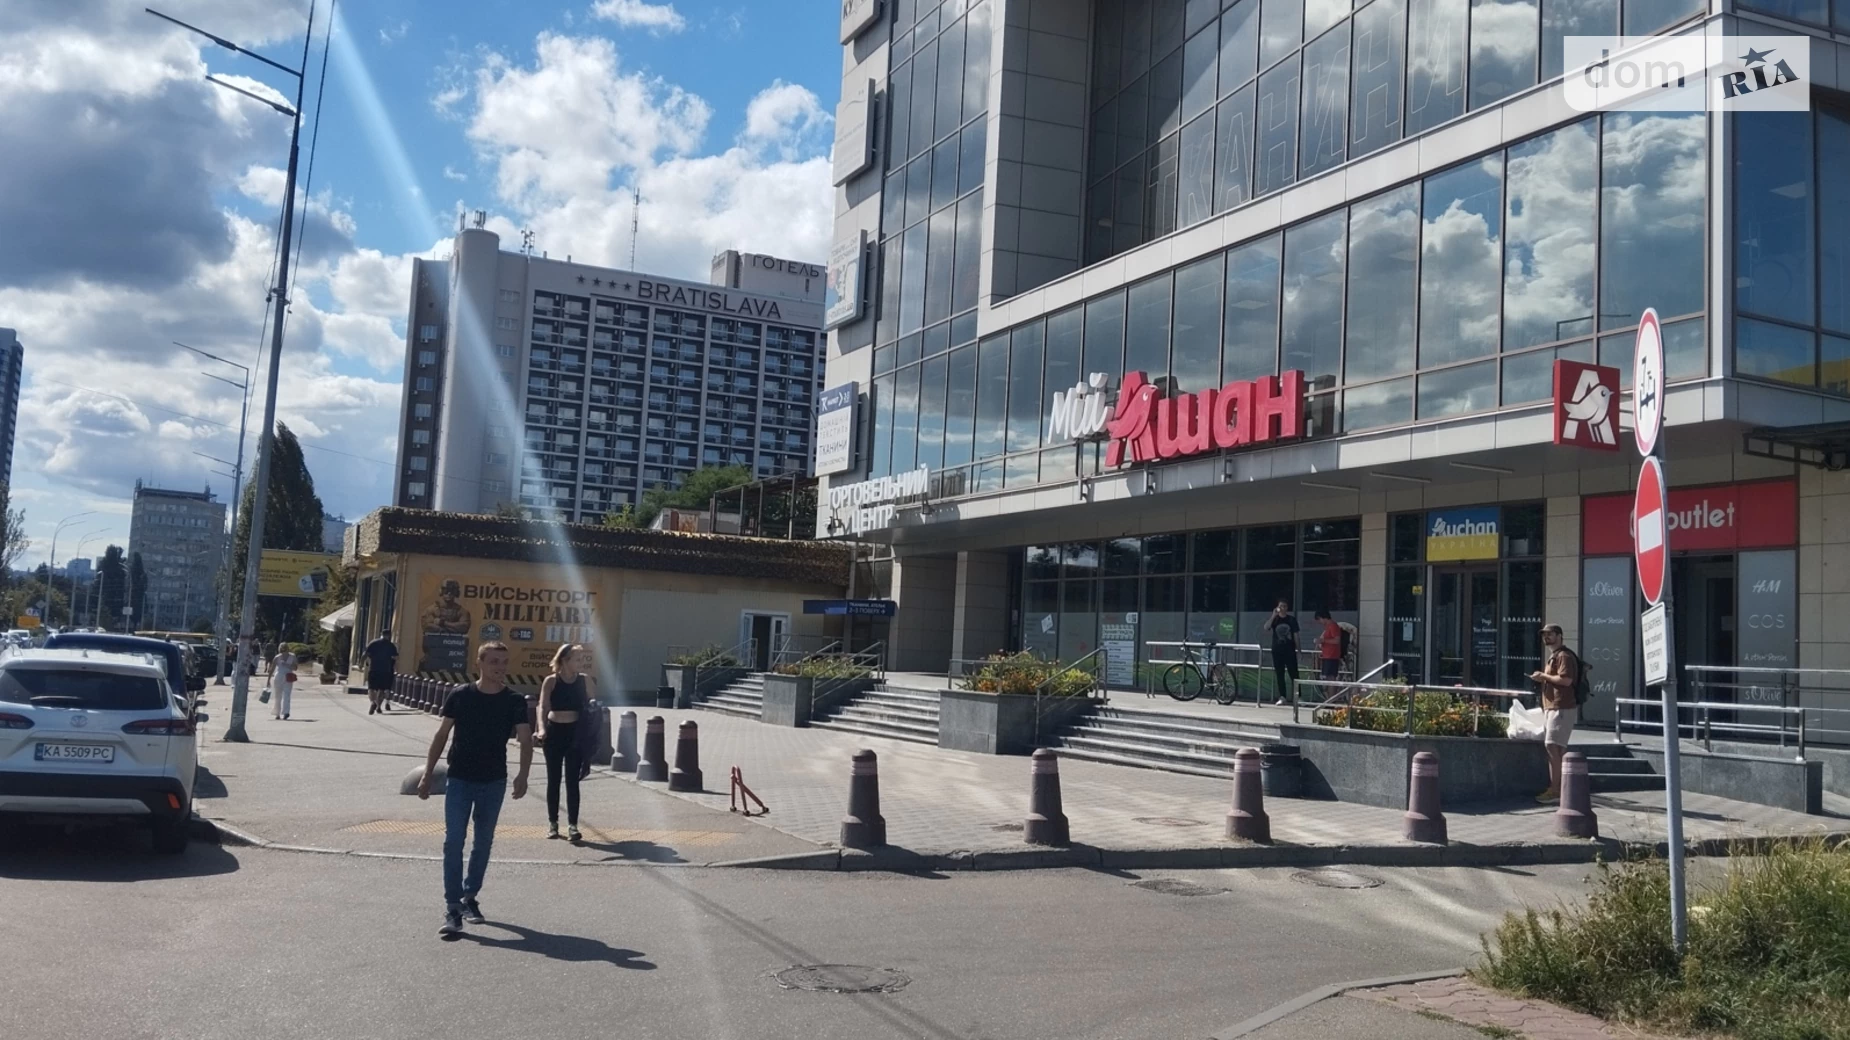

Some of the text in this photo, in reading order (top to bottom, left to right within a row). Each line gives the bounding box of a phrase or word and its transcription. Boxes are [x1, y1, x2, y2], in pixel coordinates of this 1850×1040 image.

[753, 255, 819, 278] ГОТЕЛЬ
[638, 280, 782, 319] BRATISLAVA
[828, 463, 929, 510] ТОРГОВЕЛЬНИЙ
[851, 504, 895, 538] ЦЕНТР
[1431, 537, 1496, 550] УКРАЇНА
[464, 582, 597, 604] ВІЙСЬКТОРГ
[483, 603, 596, 624] MILITARY
[1748, 614, 1786, 629] COS
[544, 624, 595, 643] HUB
[1591, 648, 1621, 661] COS
[43, 746, 109, 759] KA 5509 PC
